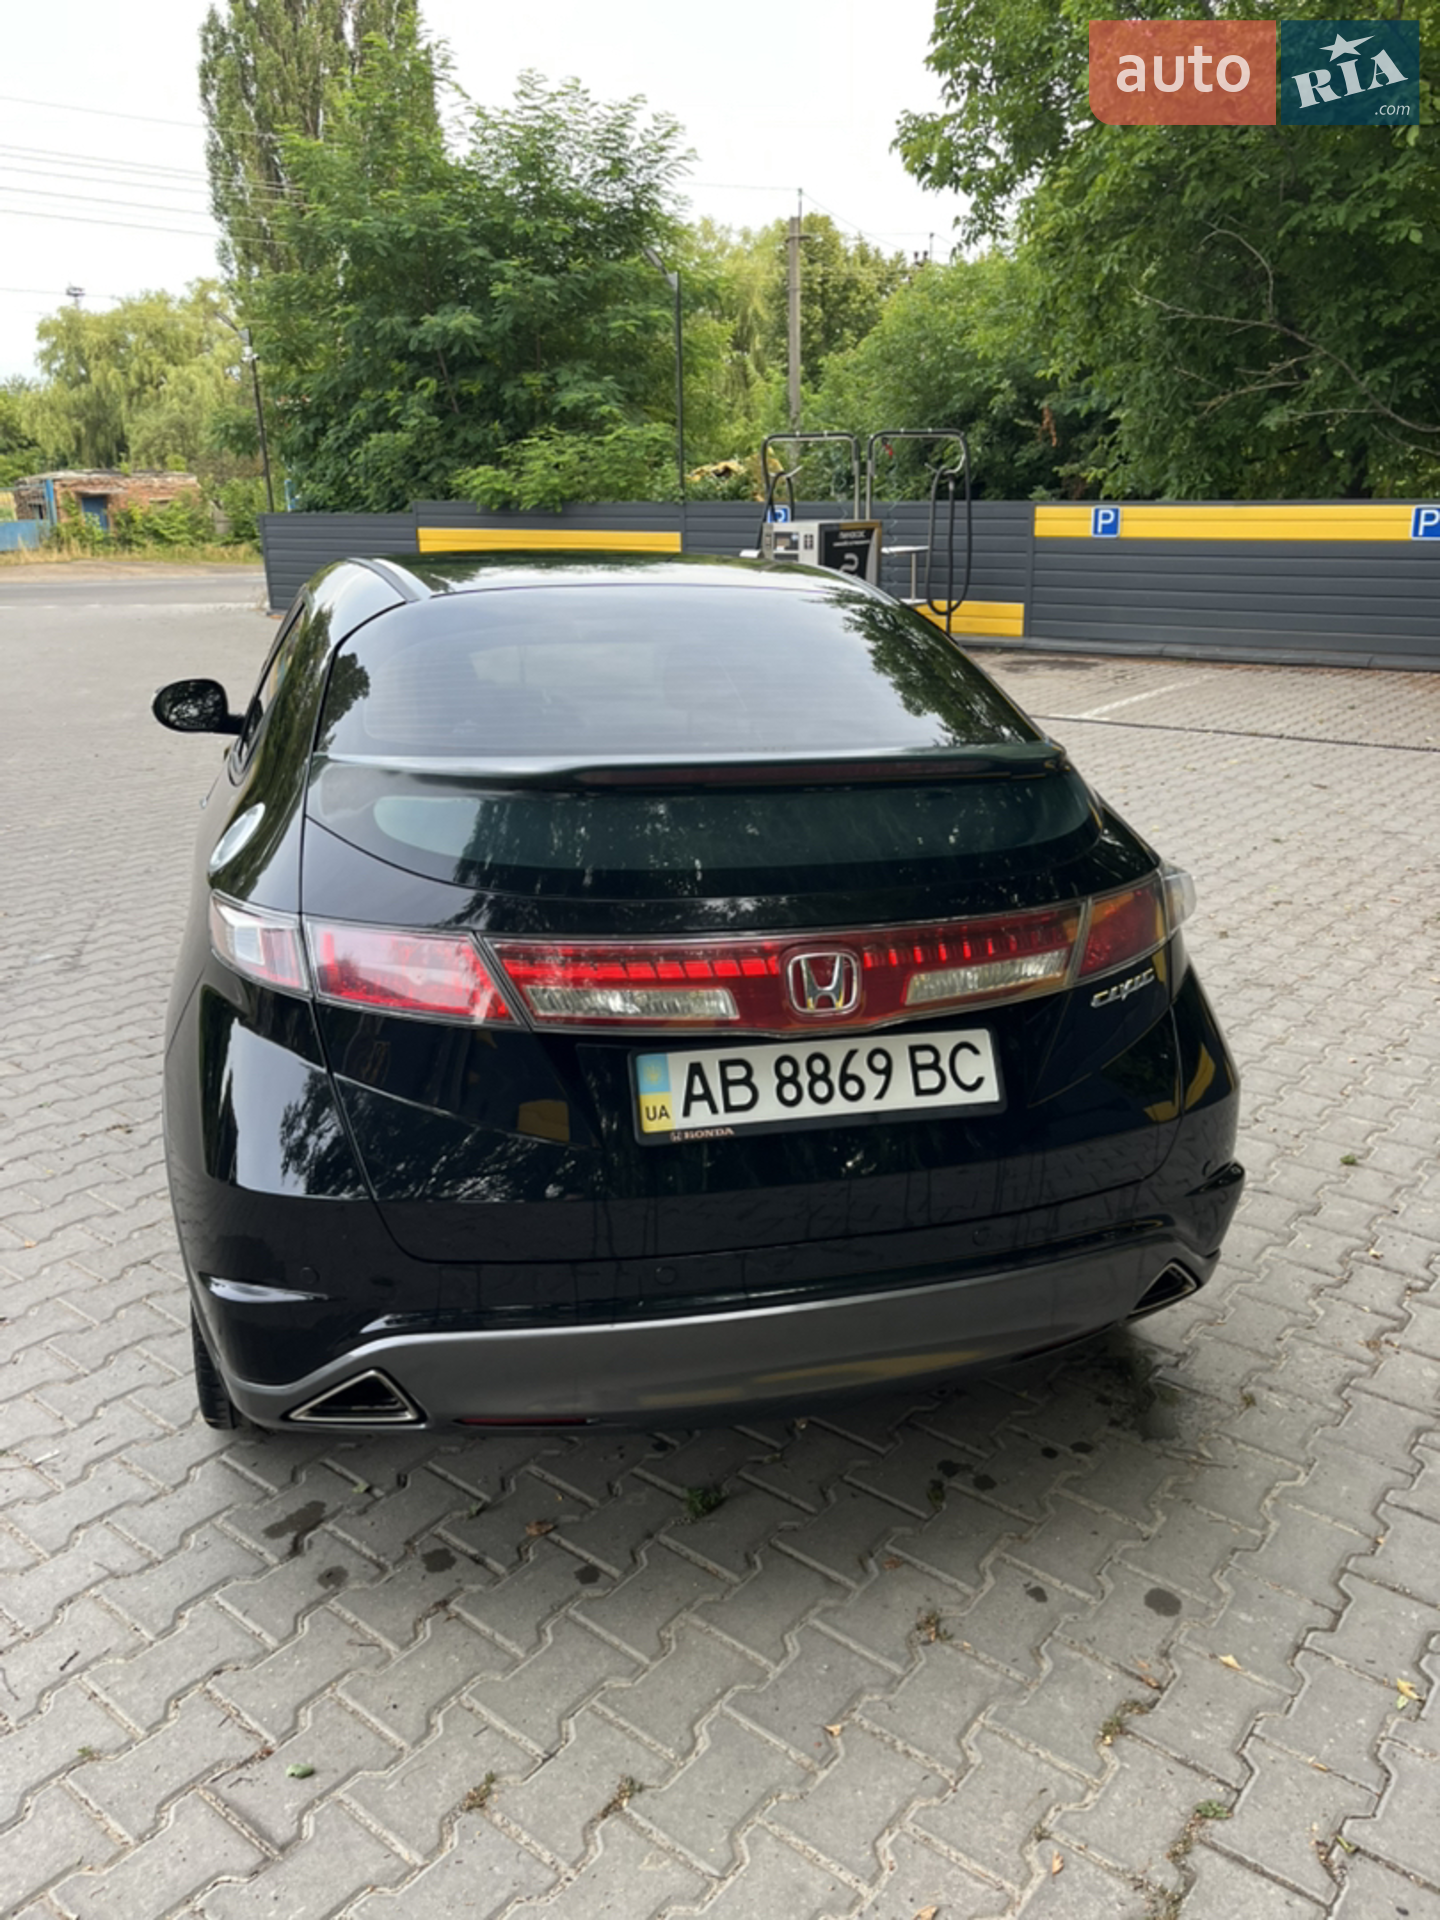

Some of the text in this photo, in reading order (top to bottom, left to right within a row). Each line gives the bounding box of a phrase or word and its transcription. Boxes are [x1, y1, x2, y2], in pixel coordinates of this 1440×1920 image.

[1098, 509, 1115, 533] P
[1418, 509, 1439, 536] P
[1091, 967, 1155, 1008] CIVIC
[682, 1041, 985, 1118] AB 8869 BC
[645, 1105, 670, 1121] UA
[684, 1127, 735, 1140] HONDA
